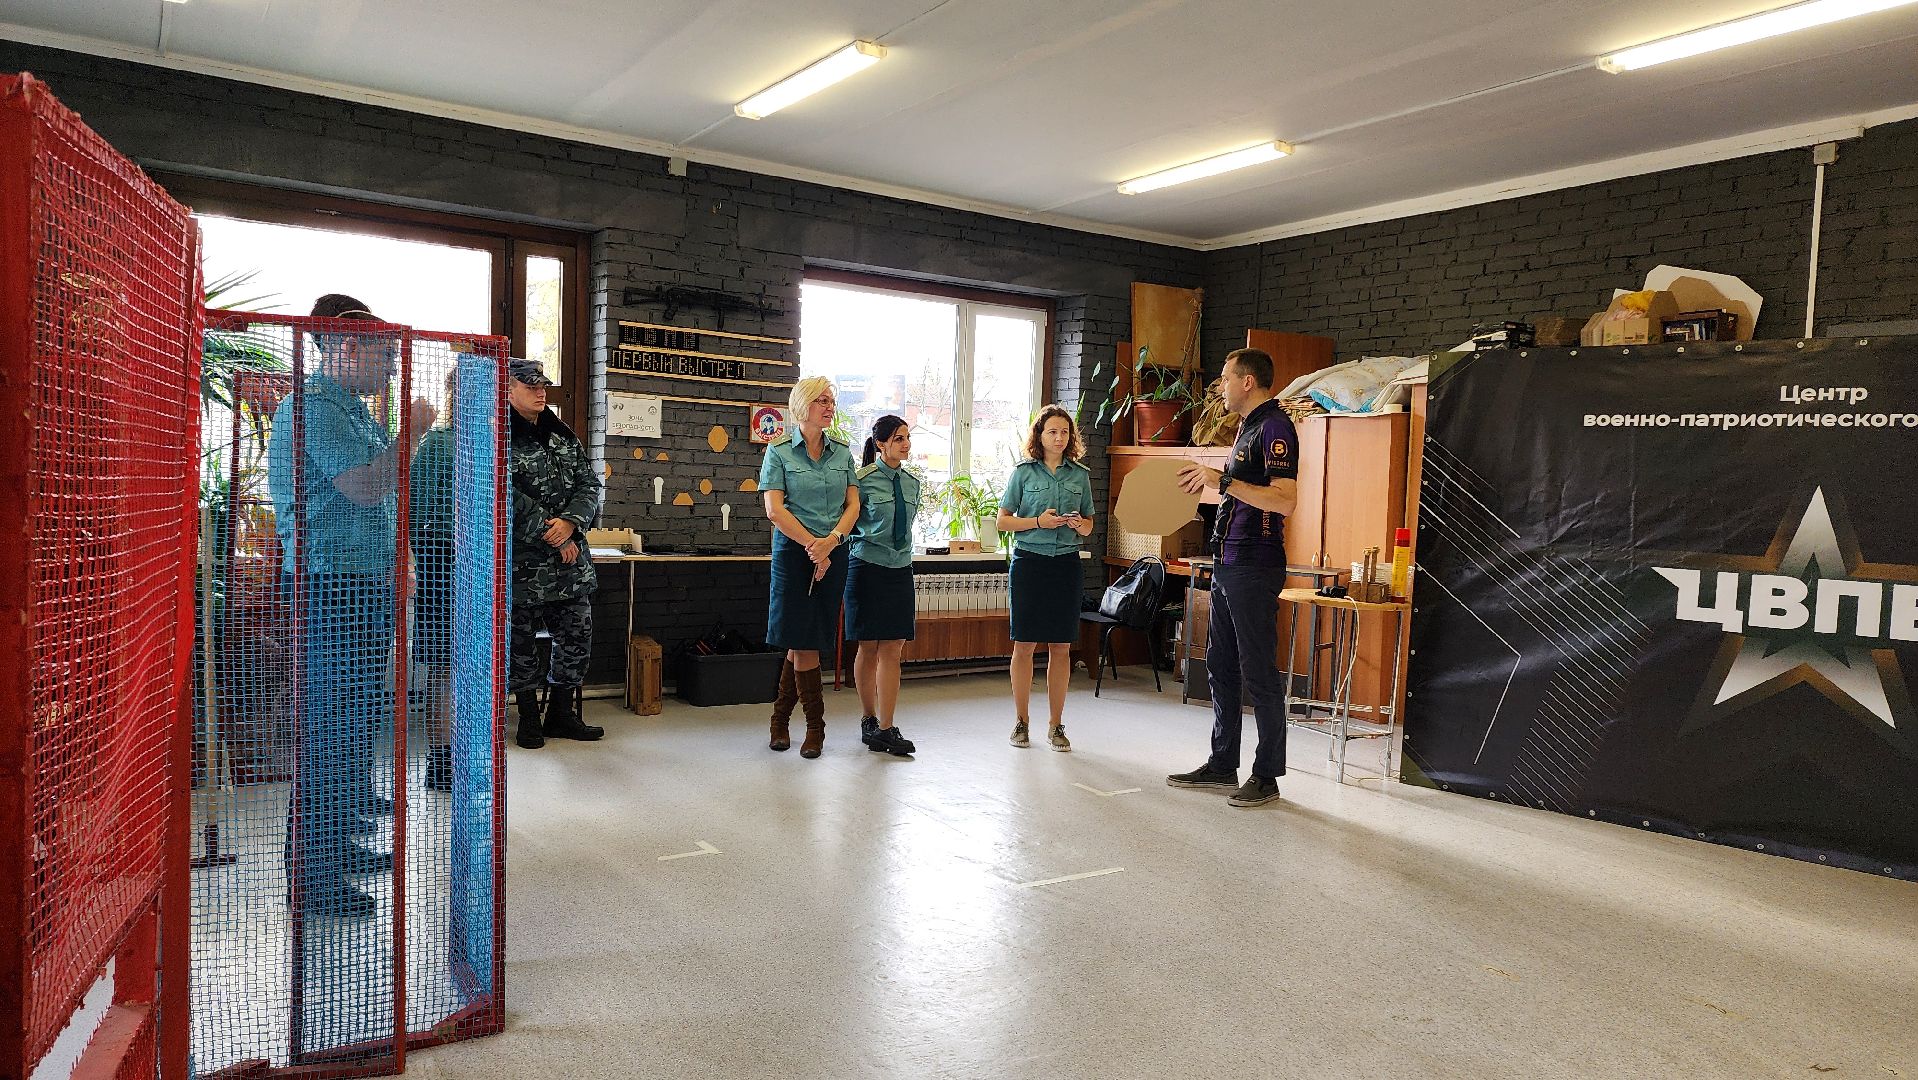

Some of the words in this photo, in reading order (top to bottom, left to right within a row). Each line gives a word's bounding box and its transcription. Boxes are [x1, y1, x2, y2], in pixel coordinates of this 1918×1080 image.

[611, 350, 673, 373] ПЕРВЫЙ
[679, 356, 746, 379] ВЫСТРЕЛ
[1779, 384, 1868, 405] Центр
[1583, 412, 1918, 431] военно-патриотического
